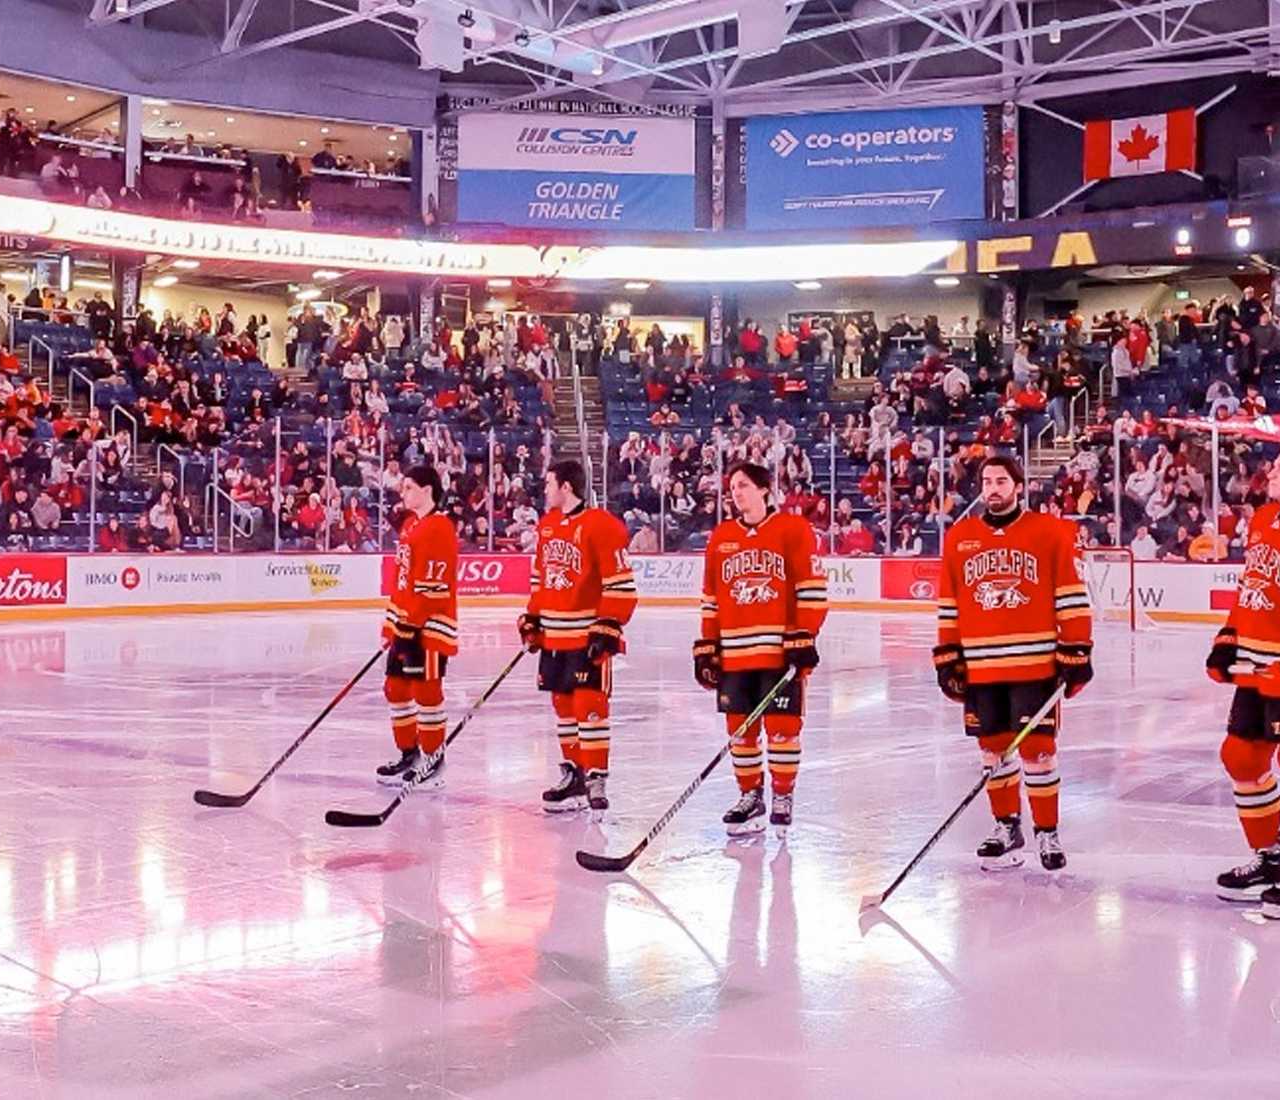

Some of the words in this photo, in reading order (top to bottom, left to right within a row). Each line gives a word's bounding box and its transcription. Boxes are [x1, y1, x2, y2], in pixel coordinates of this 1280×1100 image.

[551, 127, 638, 145] CSN
[804, 126, 956, 151] co-operators
[516, 143, 581, 155] COLLISION
[535, 181, 619, 201] GOLDEN
[527, 202, 625, 220] TRIANGLE
[425, 560, 448, 581] 17
[721, 549, 787, 583] GUELPH
[964, 548, 1039, 585] GUELPH
[85, 574, 118, 586] BMO
